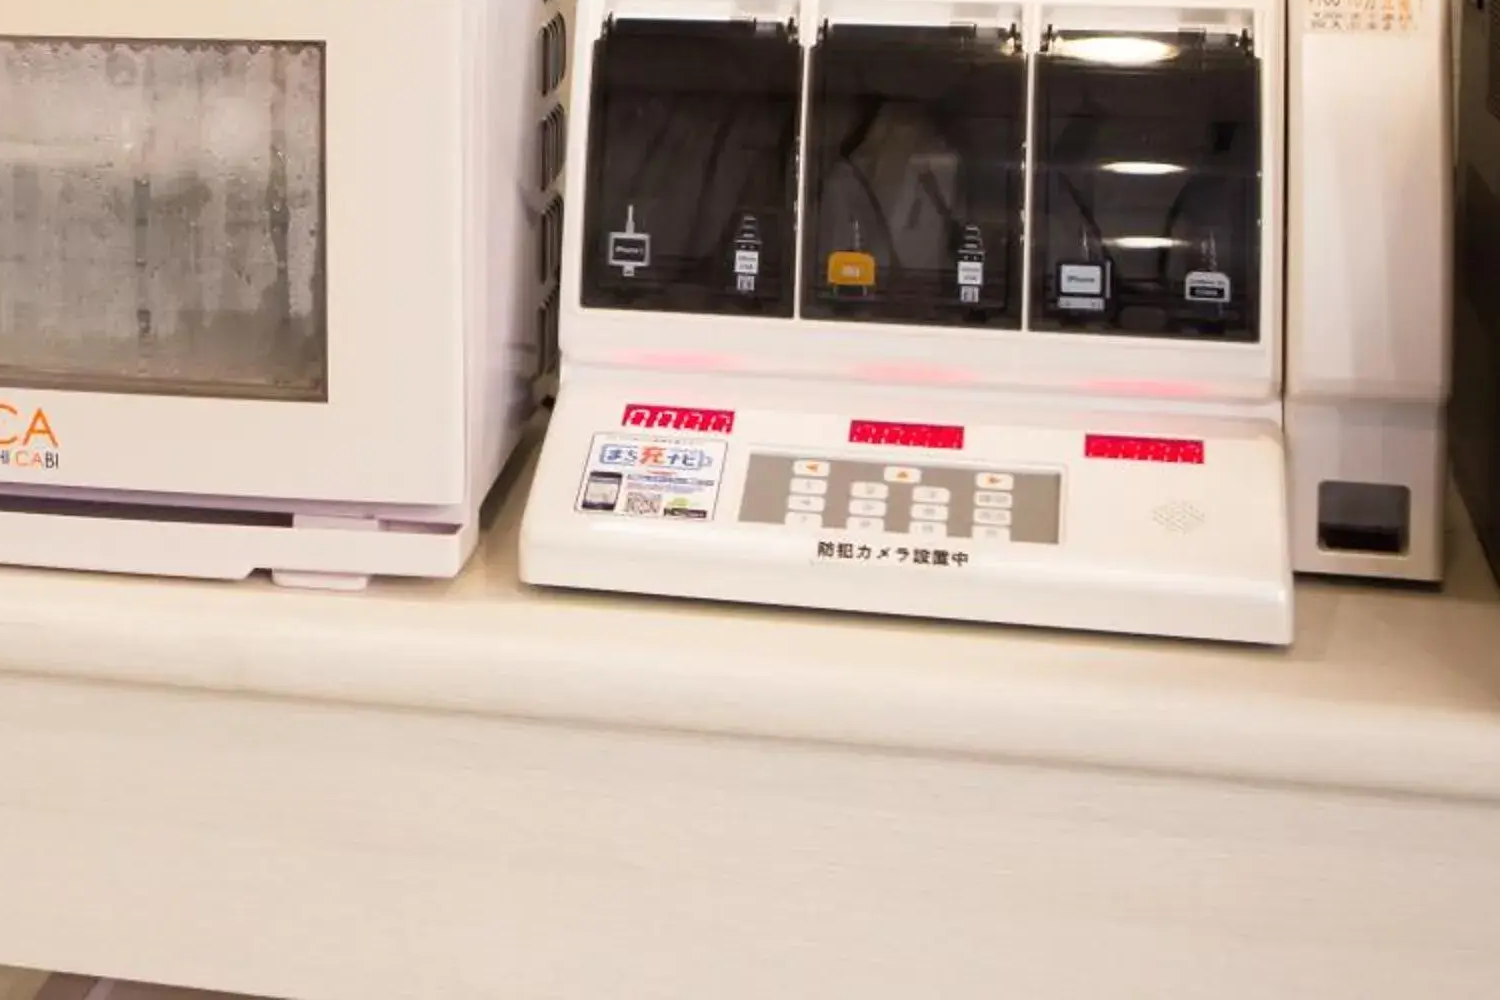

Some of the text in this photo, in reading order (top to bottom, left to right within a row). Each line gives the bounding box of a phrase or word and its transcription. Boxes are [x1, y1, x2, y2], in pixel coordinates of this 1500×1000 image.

[15, 450, 59, 469] CABI
[816, 541, 970, 567] 防犯カメラ設置中
